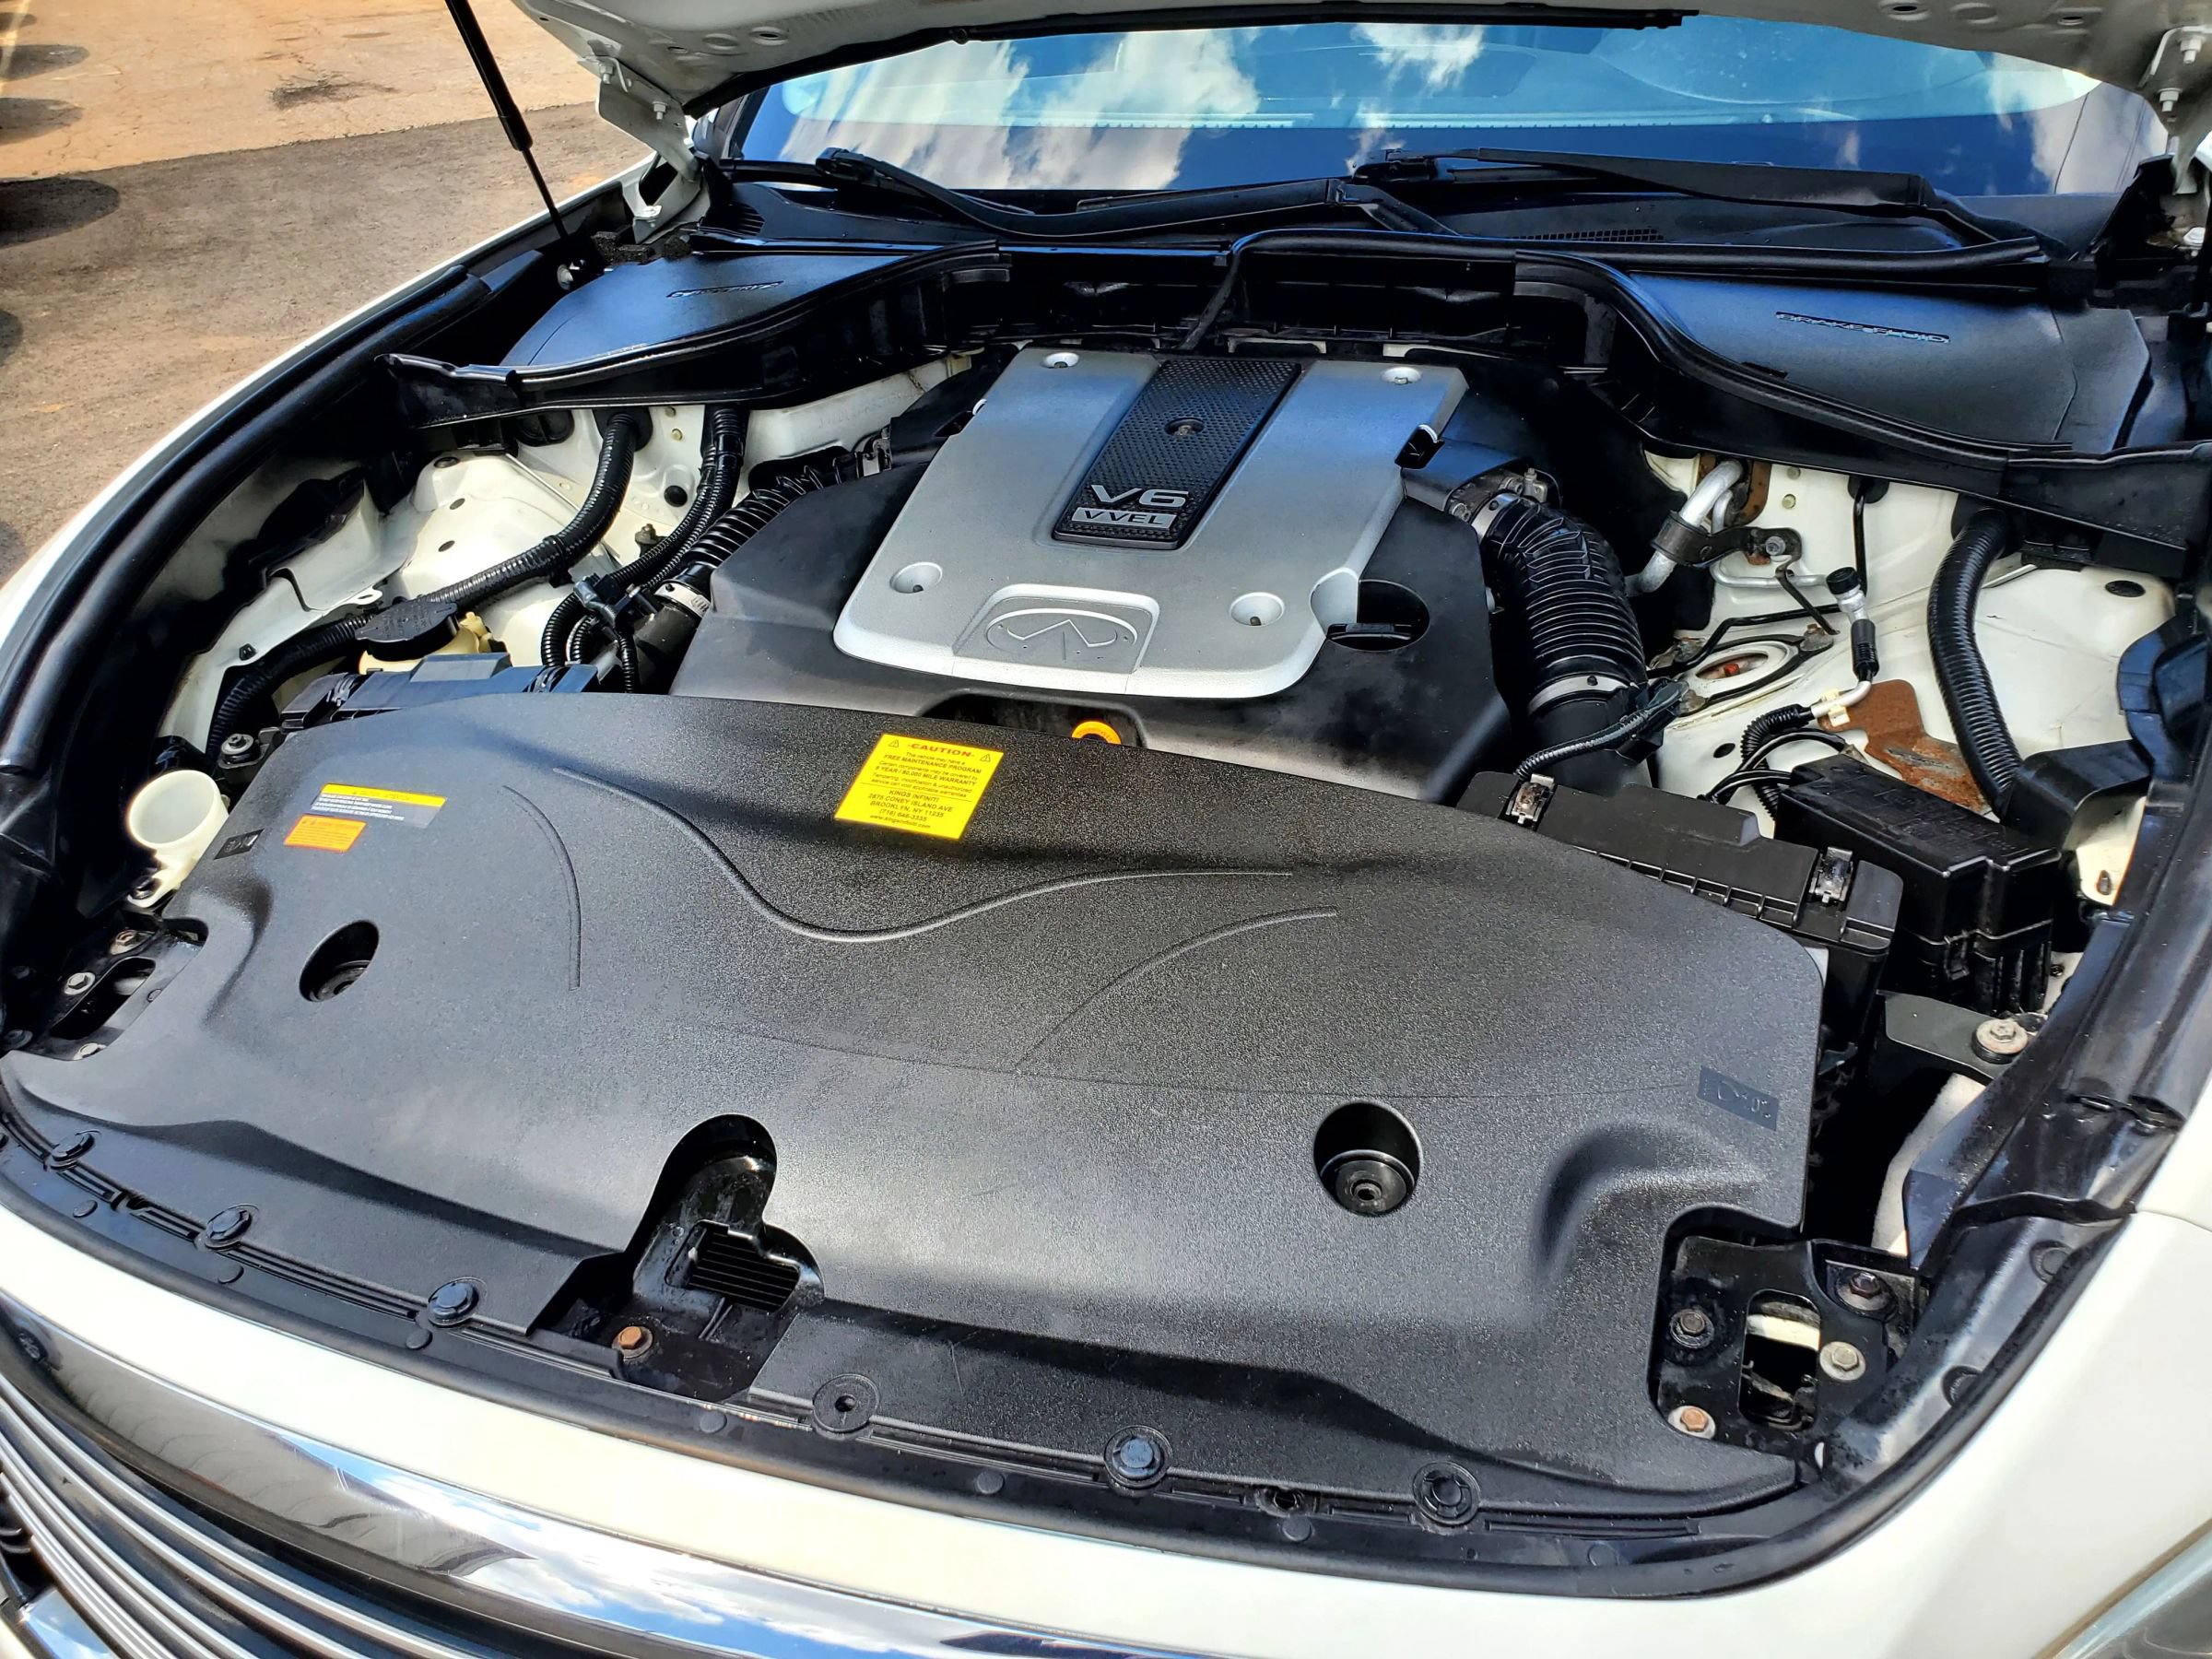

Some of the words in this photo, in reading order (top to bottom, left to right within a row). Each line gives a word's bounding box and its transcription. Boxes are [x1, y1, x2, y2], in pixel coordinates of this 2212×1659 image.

[1090, 484, 1189, 508] V6
[1084, 510, 1164, 524] VVEL
[901, 757, 947, 768] MAINTENANCE
[949, 764, 982, 773] PROGRAM
[939, 776, 977, 785] WARRANTY
[886, 795, 910, 804] CONEY
[911, 801, 937, 809] ISLAND
[912, 794, 940, 802] INFINITI
